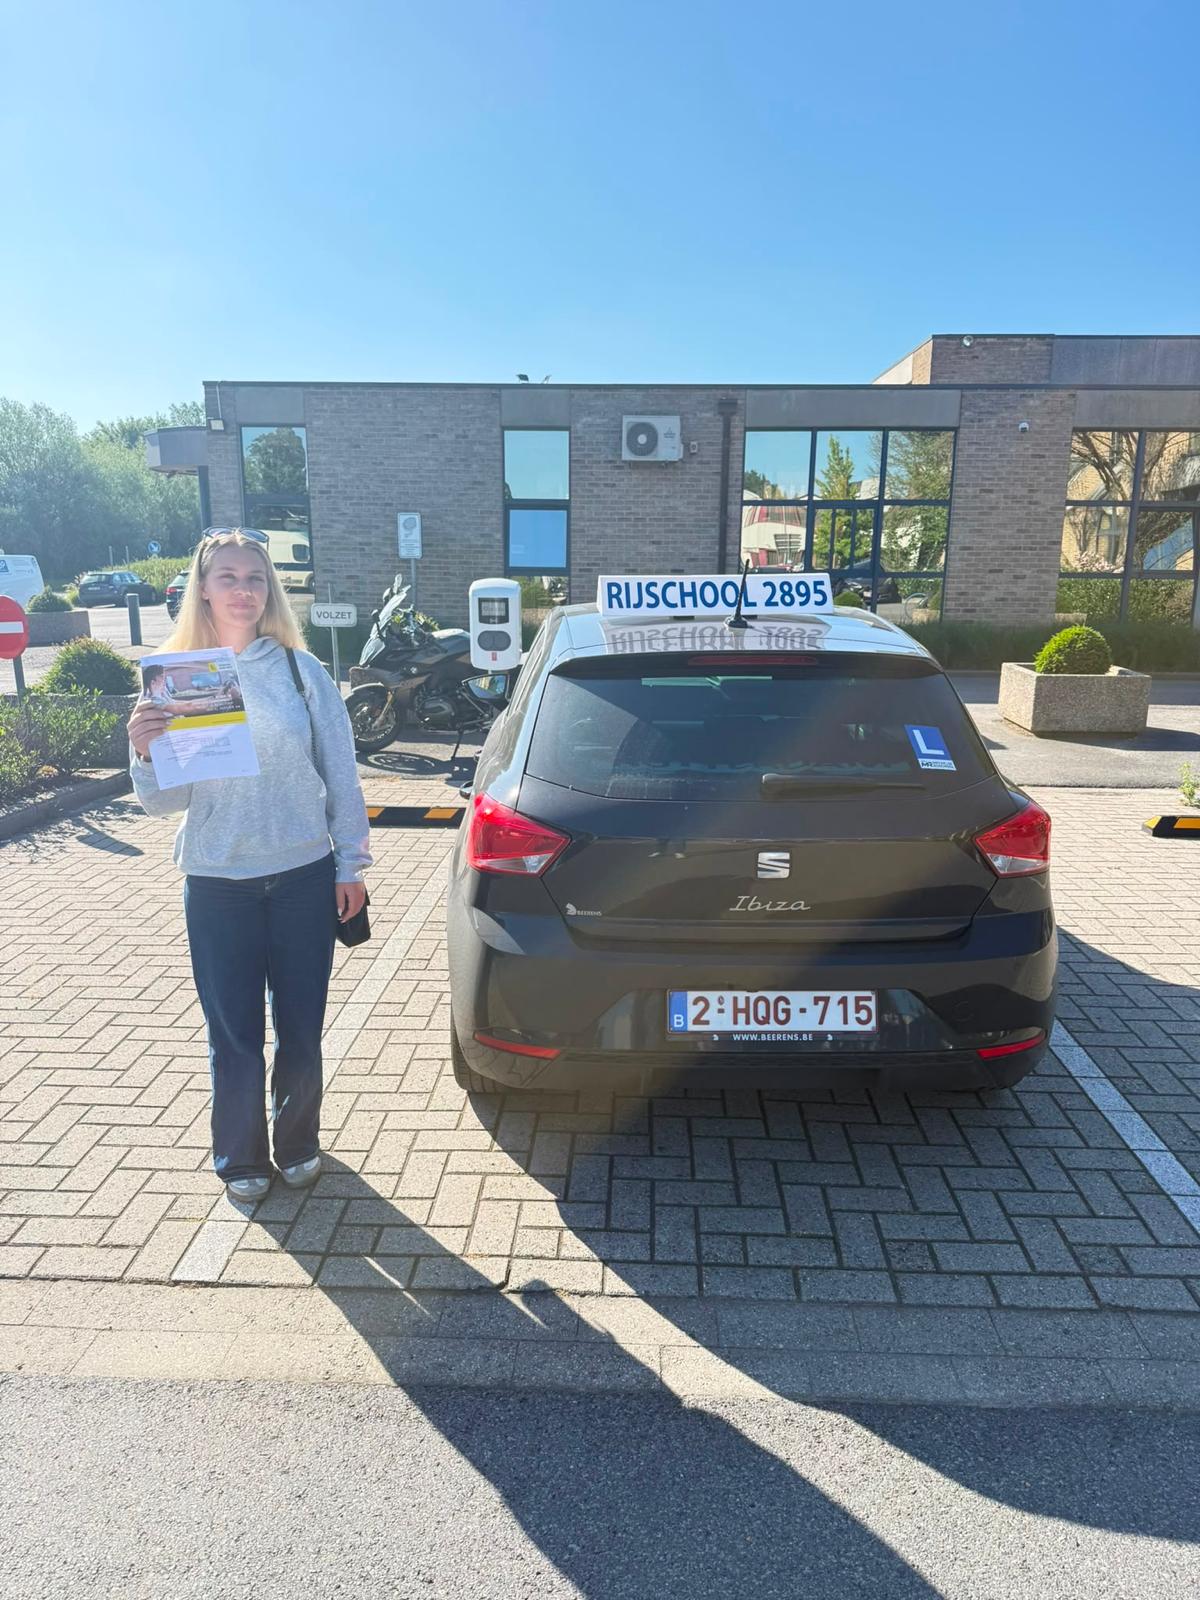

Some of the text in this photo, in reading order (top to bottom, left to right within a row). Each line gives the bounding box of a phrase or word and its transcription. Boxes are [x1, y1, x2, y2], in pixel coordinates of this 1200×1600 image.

[606, 580, 828, 609] RIJSCHOOL 2895
[316, 610, 352, 619] VOLZET
[912, 729, 945, 755] L
[729, 895, 811, 911] Ibiza
[673, 1014, 684, 1028] B
[732, 1033, 813, 1041] WWW.BEERENS.BE
